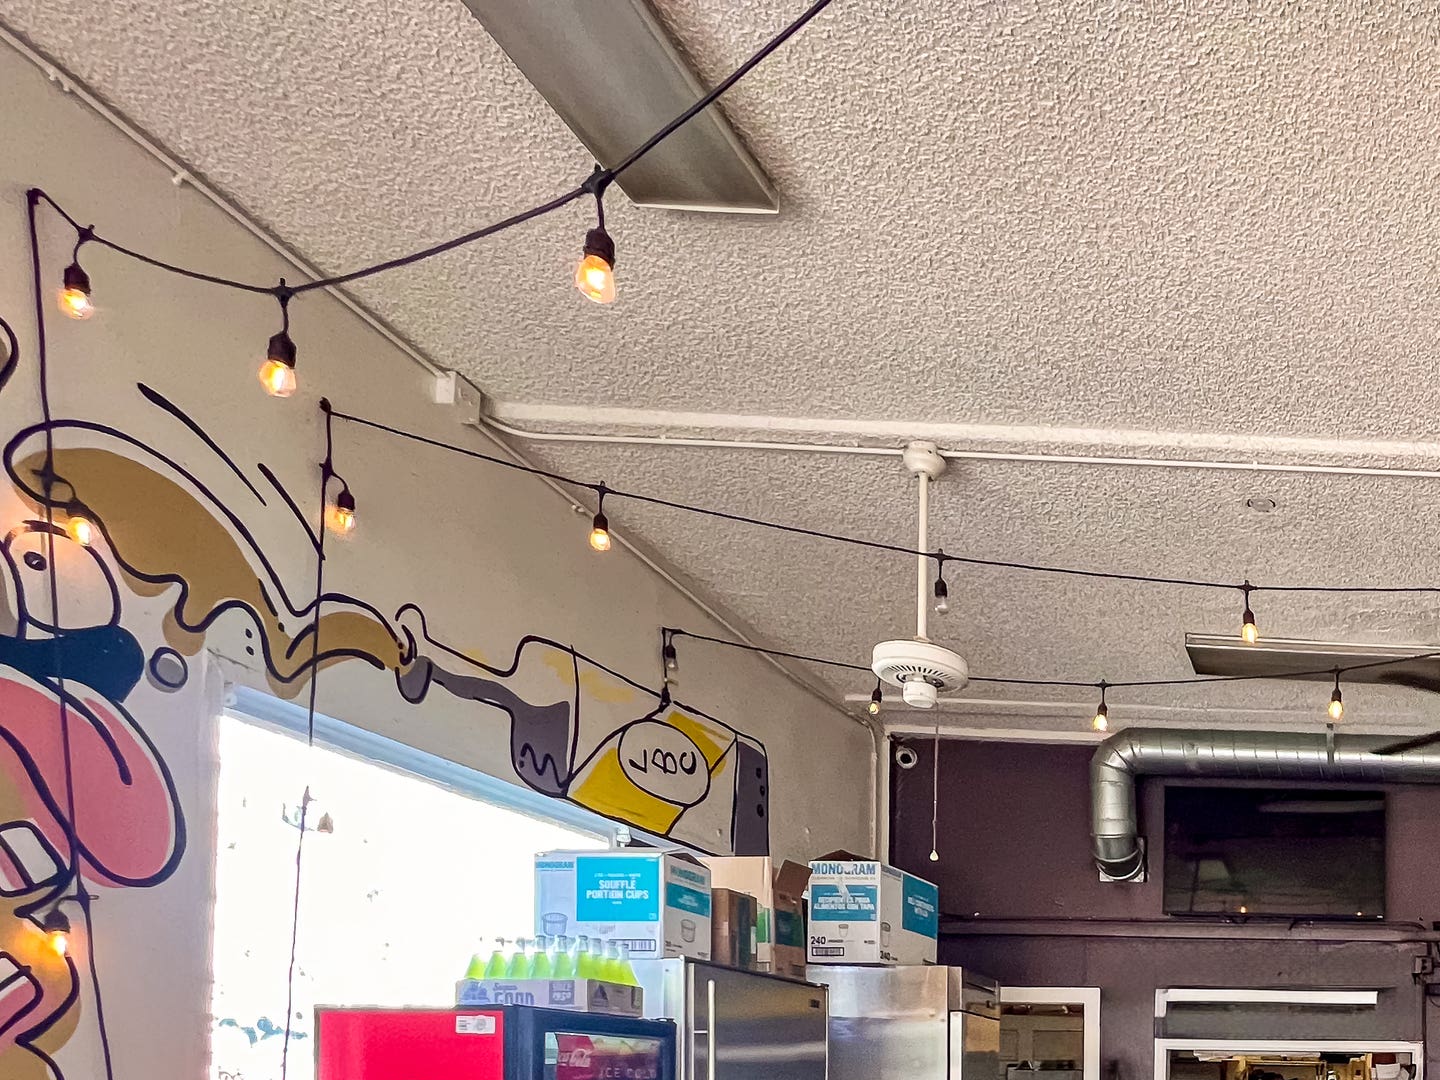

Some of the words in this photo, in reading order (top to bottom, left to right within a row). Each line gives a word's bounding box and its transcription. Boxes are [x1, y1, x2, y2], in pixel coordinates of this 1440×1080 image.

[628, 748, 697, 775] LBC
[586, 890, 624, 900] PORTION
[625, 890, 649, 900] CUPS
[810, 936, 826, 945] 240
